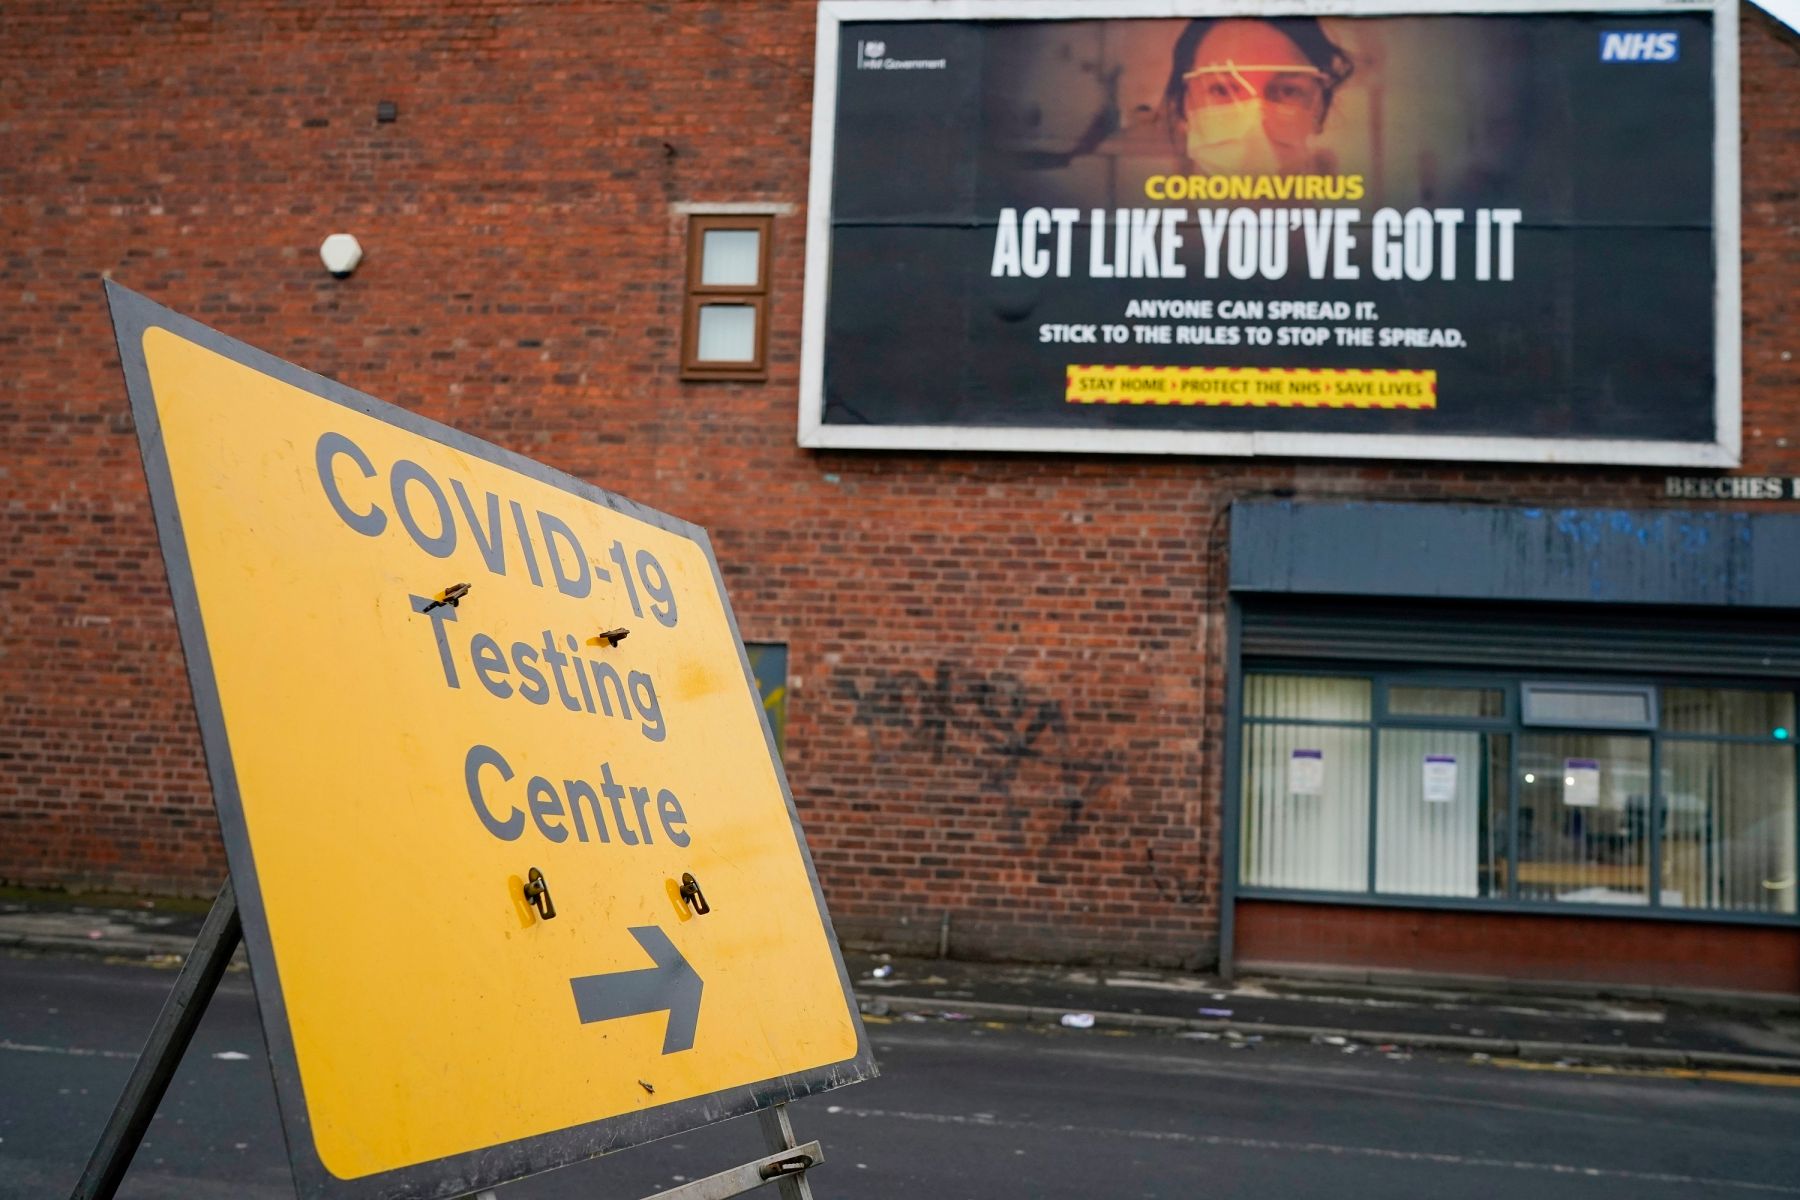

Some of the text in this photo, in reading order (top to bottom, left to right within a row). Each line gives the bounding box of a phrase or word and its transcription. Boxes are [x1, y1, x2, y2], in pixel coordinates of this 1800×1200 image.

[1601, 33, 1678, 60] NHS
[1145, 175, 1364, 200] CORONAVIRUS
[991, 207, 1080, 278] ACT
[1089, 208, 1186, 278] LIKE
[1372, 208, 1464, 281] GOT
[1475, 209, 1522, 281] IT
[1125, 300, 1379, 320] ANYONE CAN SPREAD IT.
[1039, 324, 1467, 348] STICK TO THE RULES TO STOP THE SPREAD.
[1078, 376, 1423, 396] STAY HOME PROTECT THE NHS SAVE LIVES
[1665, 476, 1783, 499] BEECHES
[315, 431, 678, 628] COVID-19
[408, 594, 666, 742] Testing
[464, 744, 691, 848] Centre
